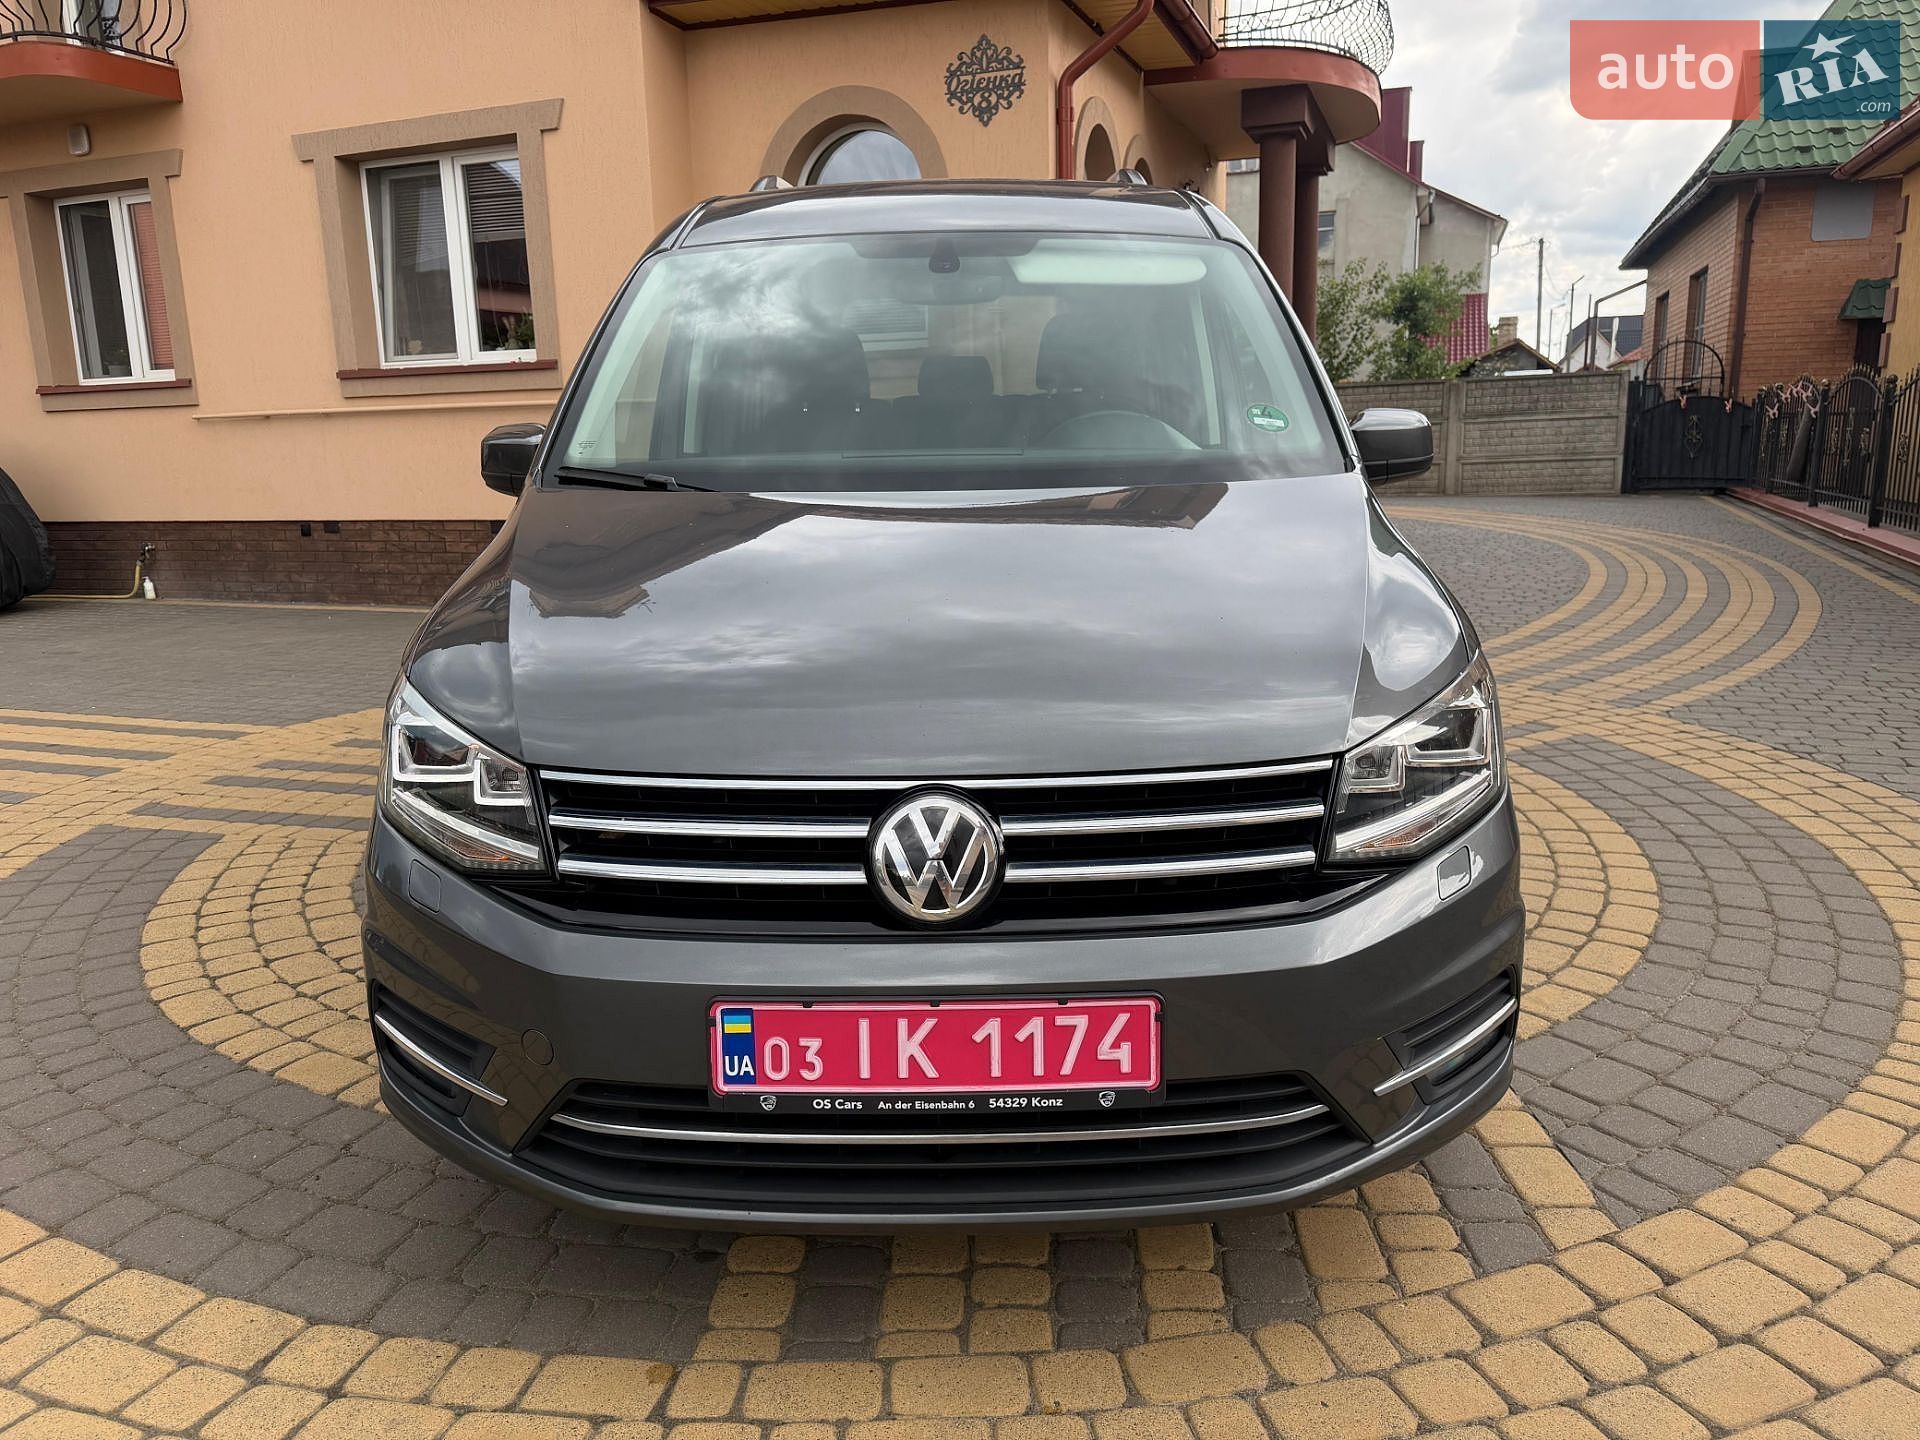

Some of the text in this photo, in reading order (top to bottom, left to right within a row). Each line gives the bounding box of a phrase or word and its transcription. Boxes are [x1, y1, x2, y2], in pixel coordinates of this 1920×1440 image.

[979, 91, 993, 111] 8
[763, 1036, 824, 1081] 03
[971, 1012, 1132, 1078] 1174
[724, 1055, 755, 1076] UA
[812, 1099, 863, 1109] OS Cars
[878, 1099, 975, 1110] An der Eisenbahn 6
[988, 1097, 1063, 1108] 54329 Konz
